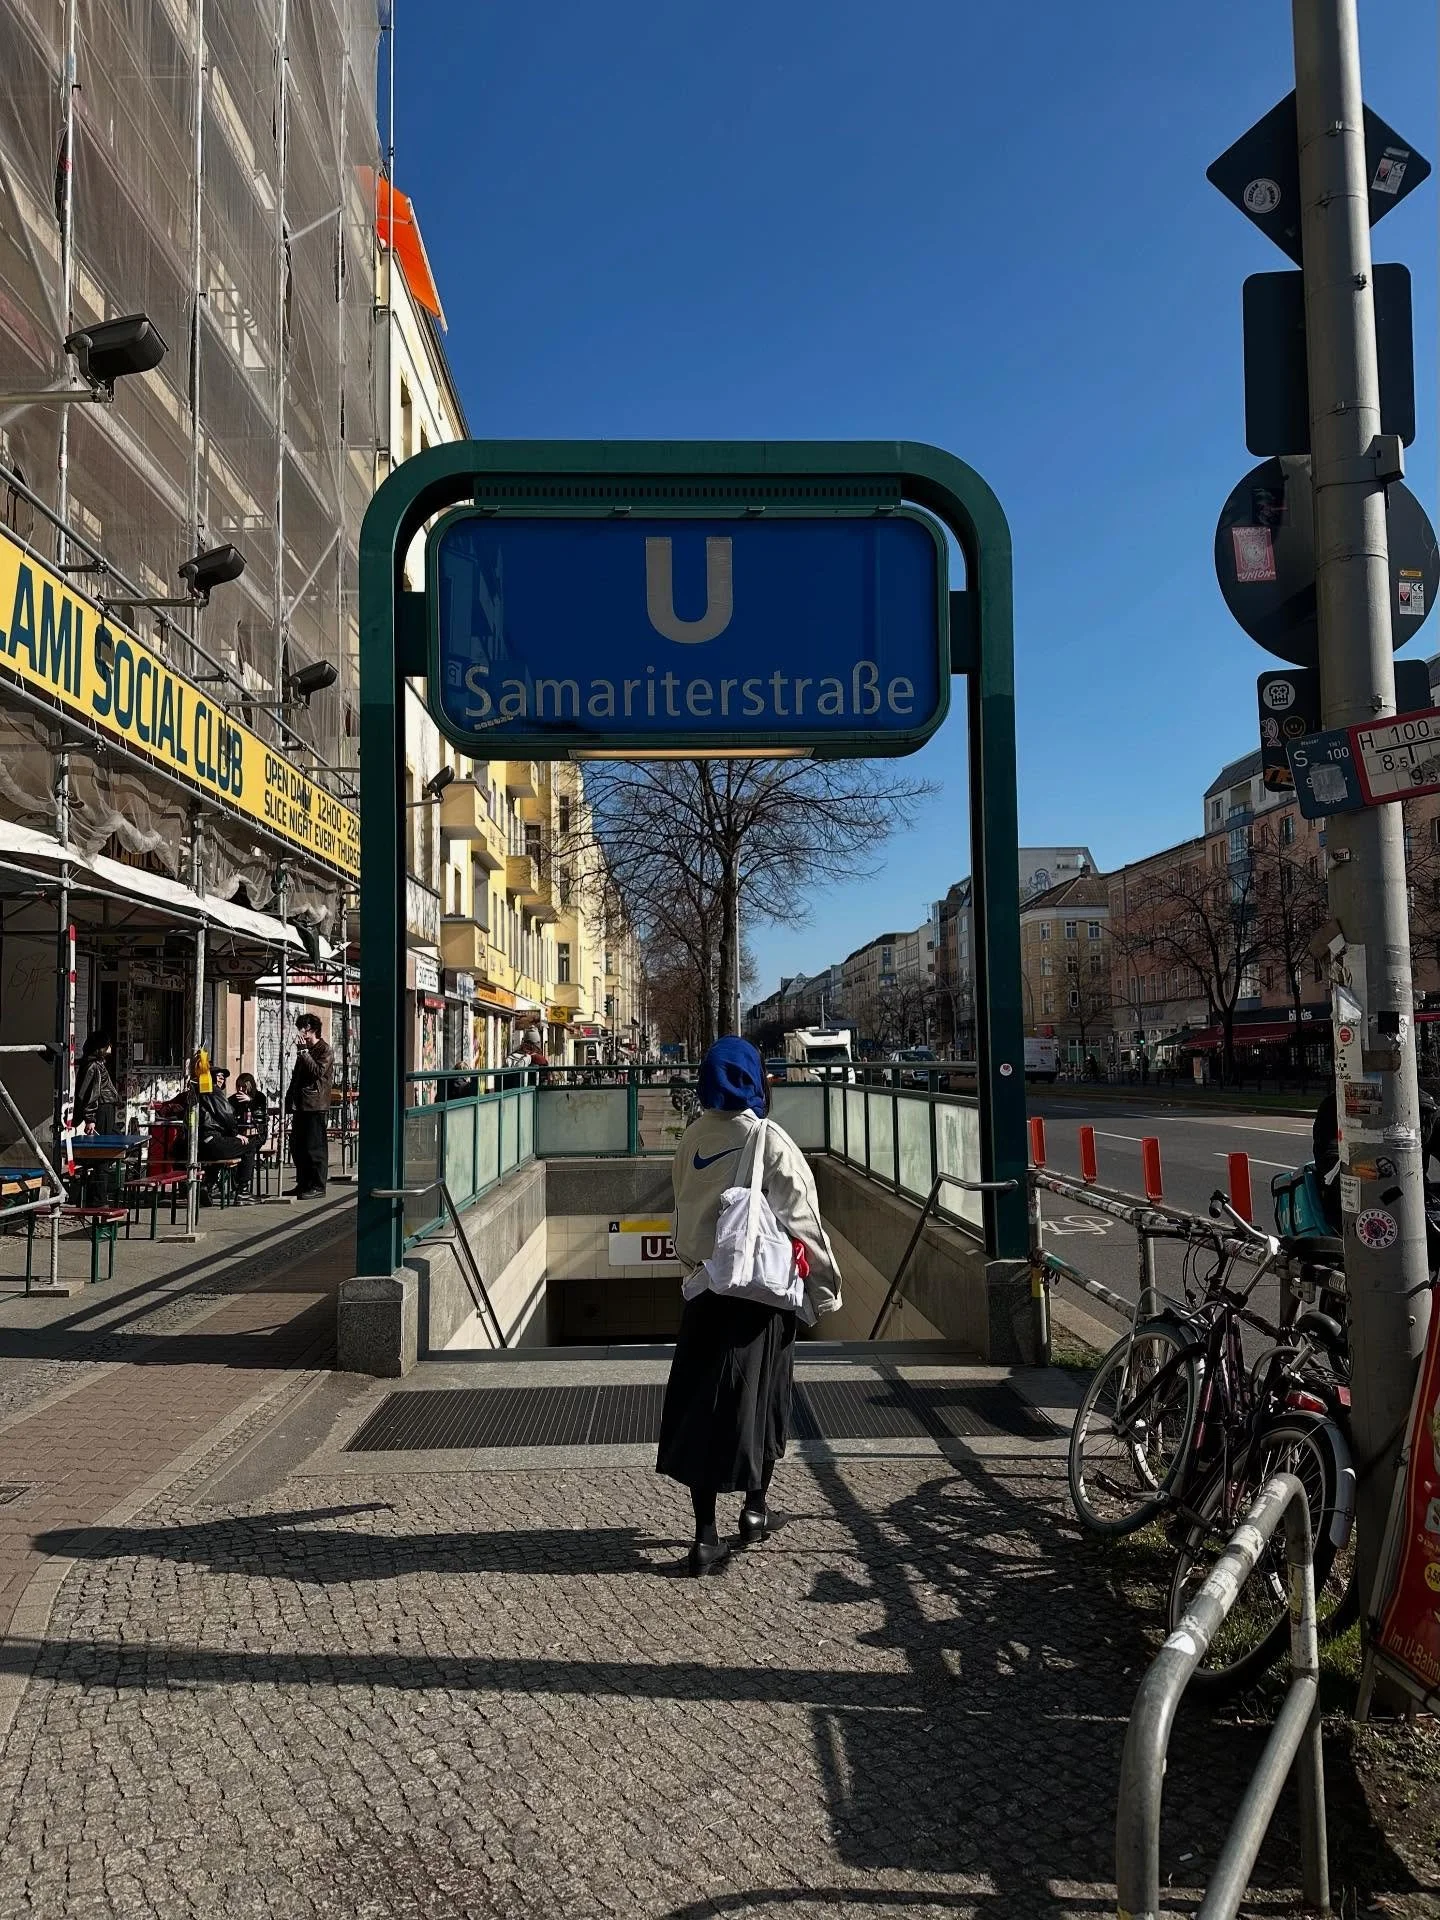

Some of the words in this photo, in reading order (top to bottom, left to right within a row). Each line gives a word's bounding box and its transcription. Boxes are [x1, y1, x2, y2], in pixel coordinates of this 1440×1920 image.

[1241, 569, 1273, 581] UNION
[645, 536, 733, 644] U
[0, 562, 83, 699] AMI
[92, 623, 188, 766] SOCIAL
[194, 701, 243, 798] CLUB
[464, 660, 915, 717] Samariterstraße
[1358, 732, 1375, 750] H
[1390, 720, 1430, 742] 100
[1293, 750, 1308, 767] S
[1326, 746, 1350, 761] 100
[1382, 754, 1408, 771] 8.5
[1411, 767, 1438, 785] 9.5
[264, 753, 289, 797] OPEN
[317, 793, 342, 833] 12H00
[264, 789, 287, 827] SLICE
[289, 807, 313, 843] NIGHT
[314, 823, 336, 856] EVERY
[611, 1223, 618, 1231] A
[1367, 1230, 1394, 1247] BEAR
[646, 1238, 676, 1258] U5
[1387, 1625, 1404, 1653] Im
